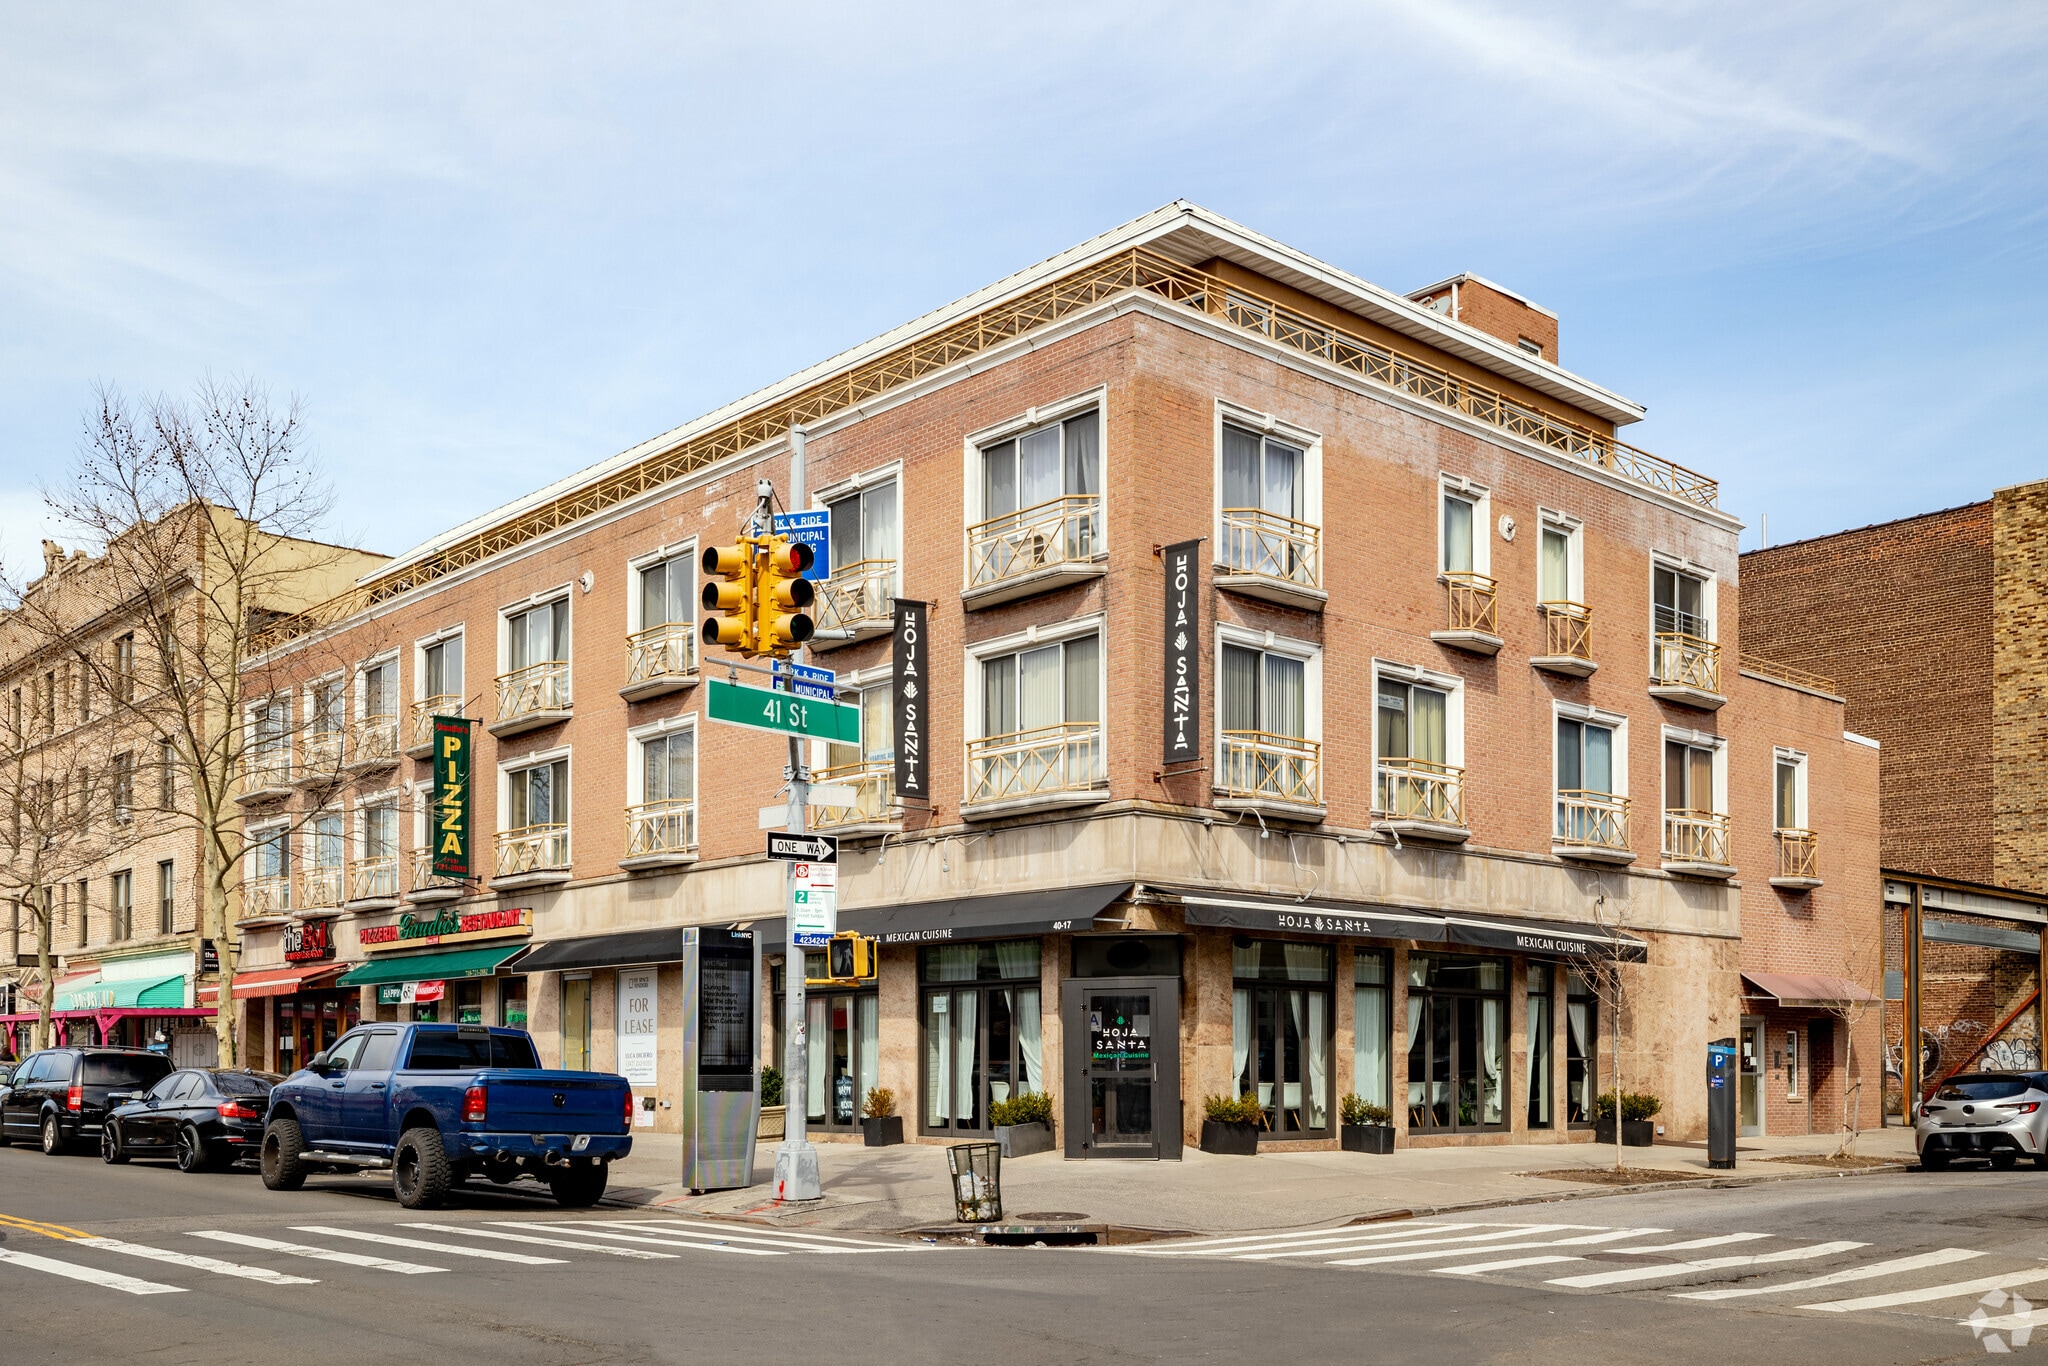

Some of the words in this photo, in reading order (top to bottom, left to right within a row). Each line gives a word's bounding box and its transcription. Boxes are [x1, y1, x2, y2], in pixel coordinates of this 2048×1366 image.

[801, 515, 823, 526] RIDE
[787, 530, 826, 543] UNICIPAL
[1174, 554, 1188, 628] HOJA
[903, 611, 918, 677] HOJA
[812, 672, 829, 682] RIDE
[795, 683, 832, 700] MUNICIPAL
[1173, 656, 1189, 750] SANTA
[763, 698, 781, 724] 41
[789, 702, 808, 728] St
[904, 703, 919, 790] SANTA
[440, 735, 462, 855] PIZZA
[777, 840, 798, 853] ONE
[806, 843, 827, 855] WAY
[797, 891, 805, 903] 2
[359, 925, 399, 944] PIZZERIA
[399, 907, 460, 940] Gaudio's
[461, 908, 522, 933] RESTAURANT
[1053, 920, 1072, 930] 40-17
[1278, 914, 1312, 929] HOJA
[1326, 918, 1371, 932] SANTA
[283, 925, 302, 953] the
[731, 931, 752, 939] LinkNYC
[886, 931, 920, 943] MEXICAN
[921, 928, 953, 940] CUISINE
[1516, 935, 1554, 950] MEXICAN
[1555, 940, 1587, 954] CUISINE
[629, 997, 649, 1013] FOR
[624, 1018, 654, 1035] LEASE
[1091, 1013, 1099, 1026] A
[1102, 1027, 1139, 1037] HOJA
[1096, 1040, 1147, 1050] SANTA
[1093, 1051, 1122, 1059] Mexican
[1123, 1051, 1149, 1059] Cuisine
[1715, 1054, 1723, 1067] P
